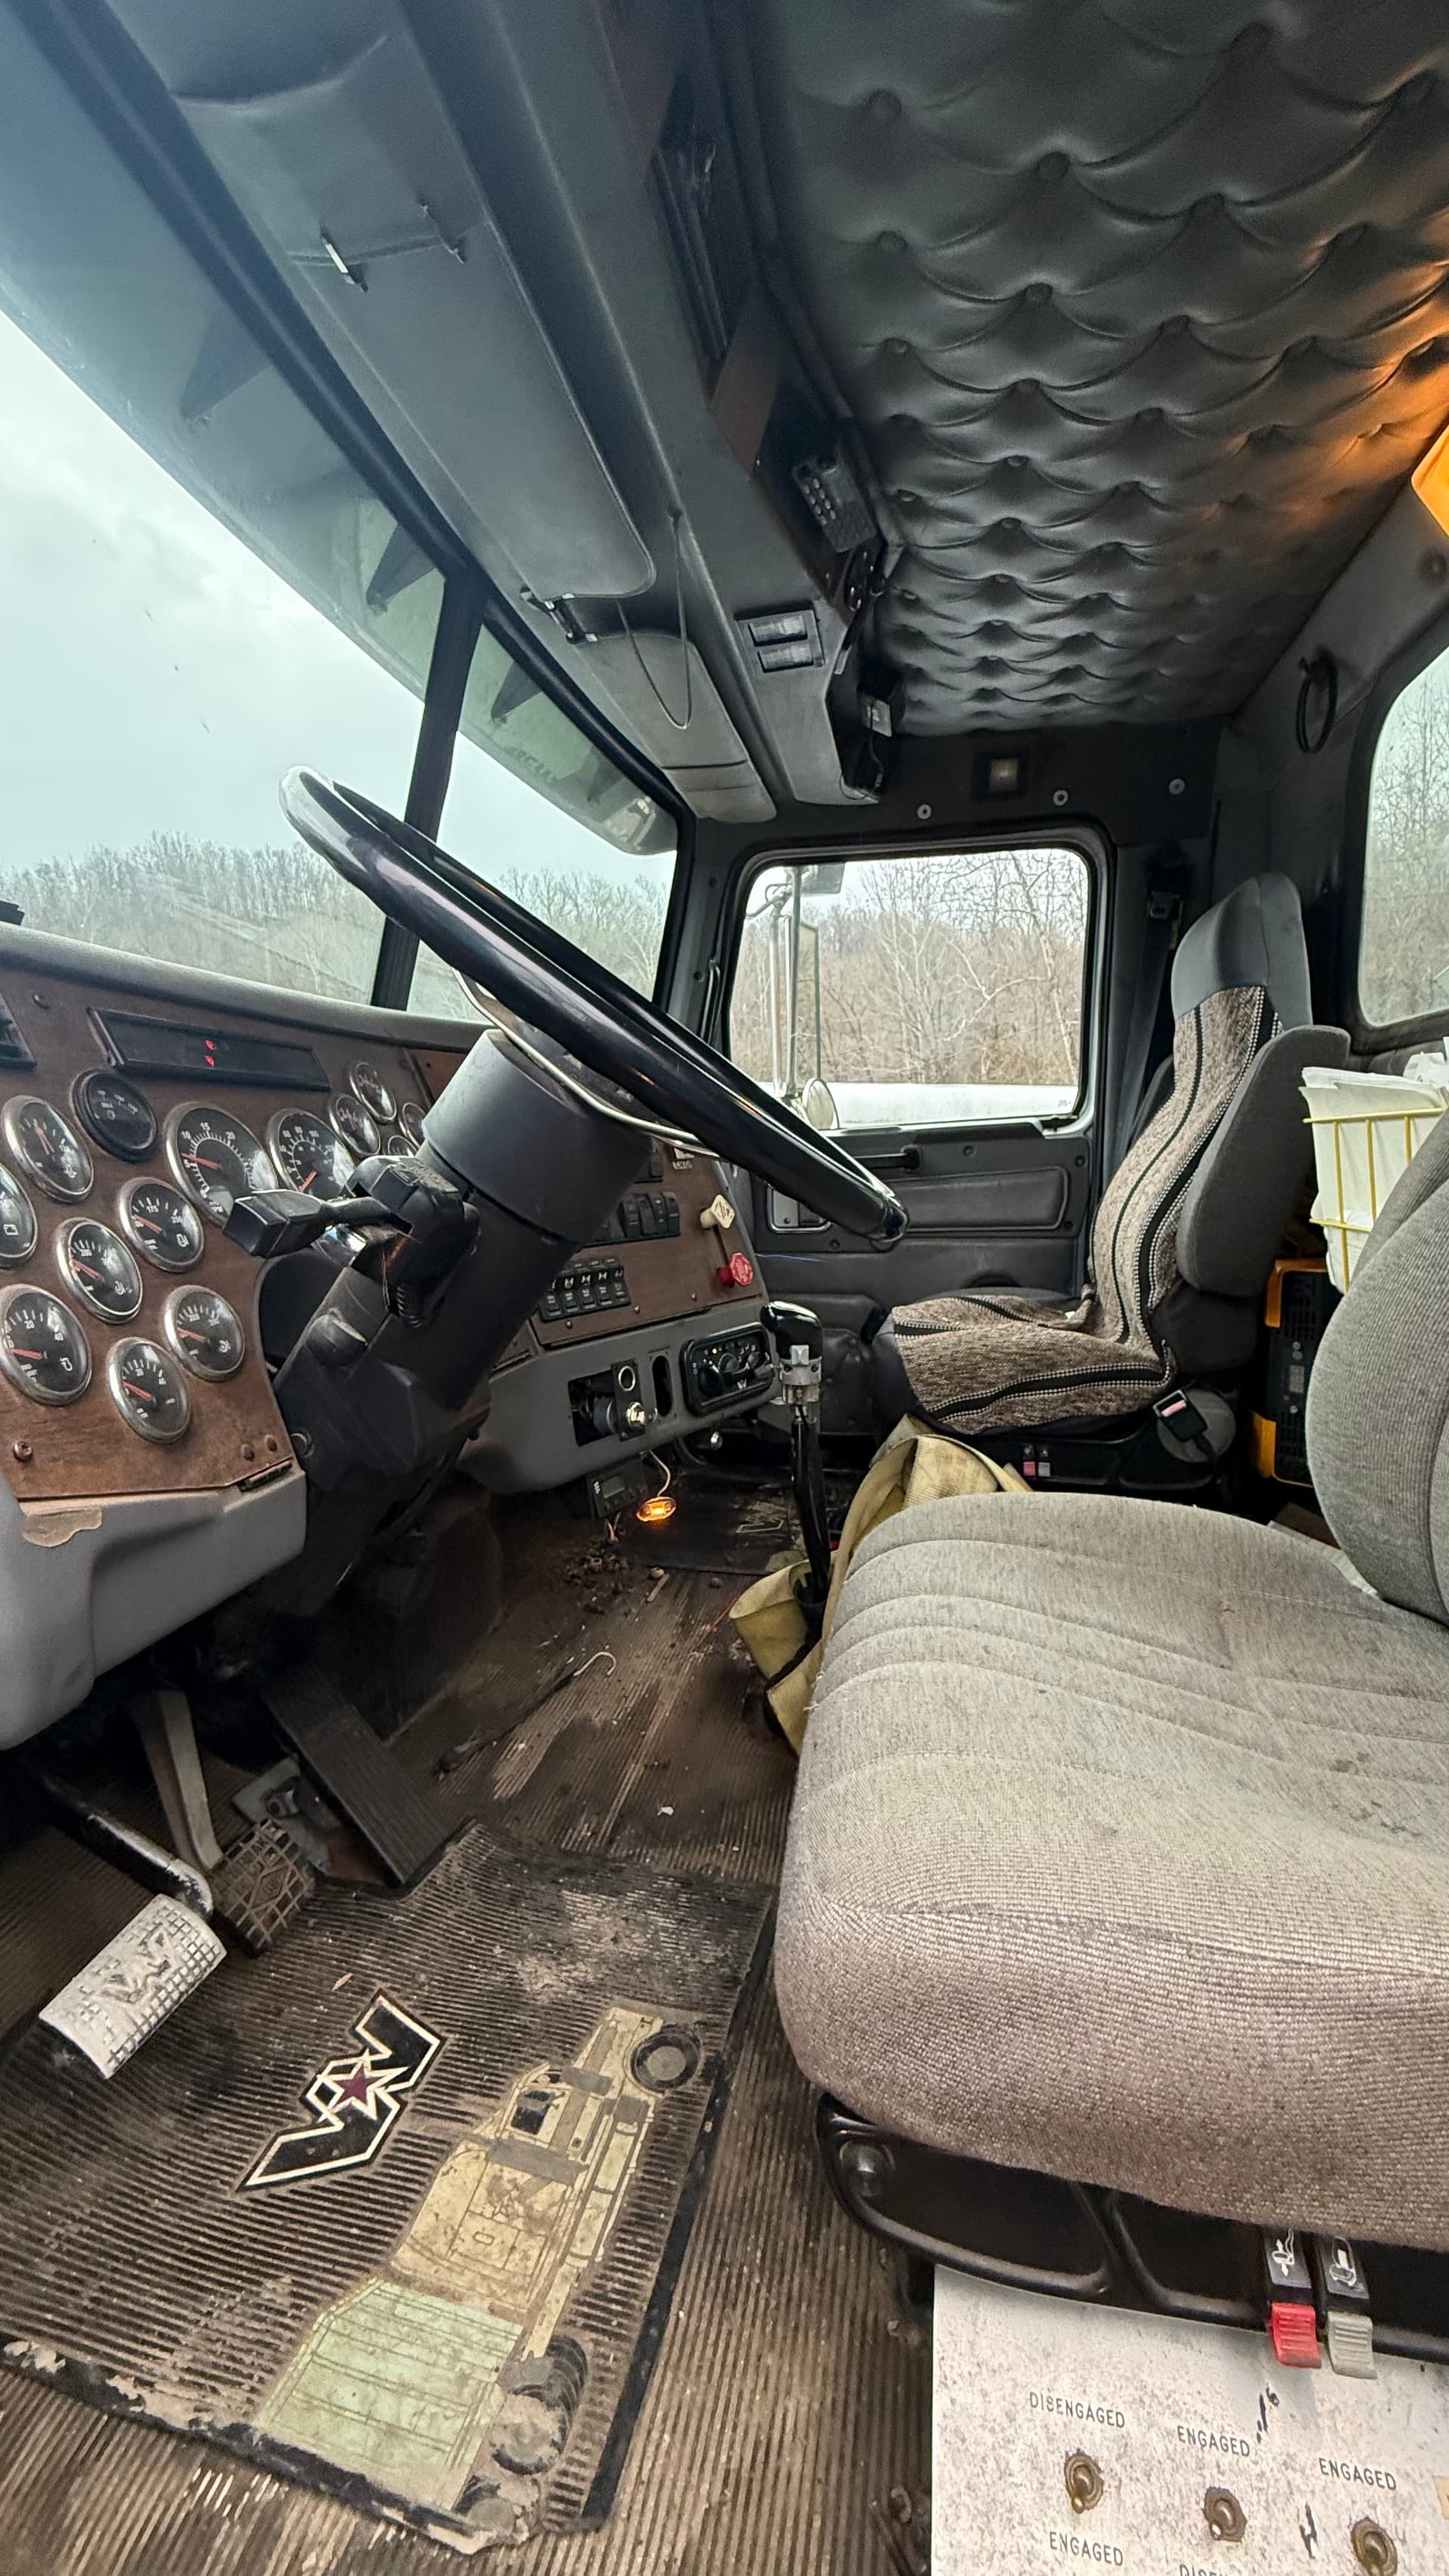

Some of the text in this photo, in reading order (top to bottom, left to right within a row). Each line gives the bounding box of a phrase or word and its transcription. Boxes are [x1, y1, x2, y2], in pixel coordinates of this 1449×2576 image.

[1029, 2391, 1125, 2429] DISENGAGED
[1177, 2424, 1251, 2458] ENGAGED
[1318, 2457, 1397, 2491] ENGAGED
[1049, 2530, 1124, 2567] ENGAGED
